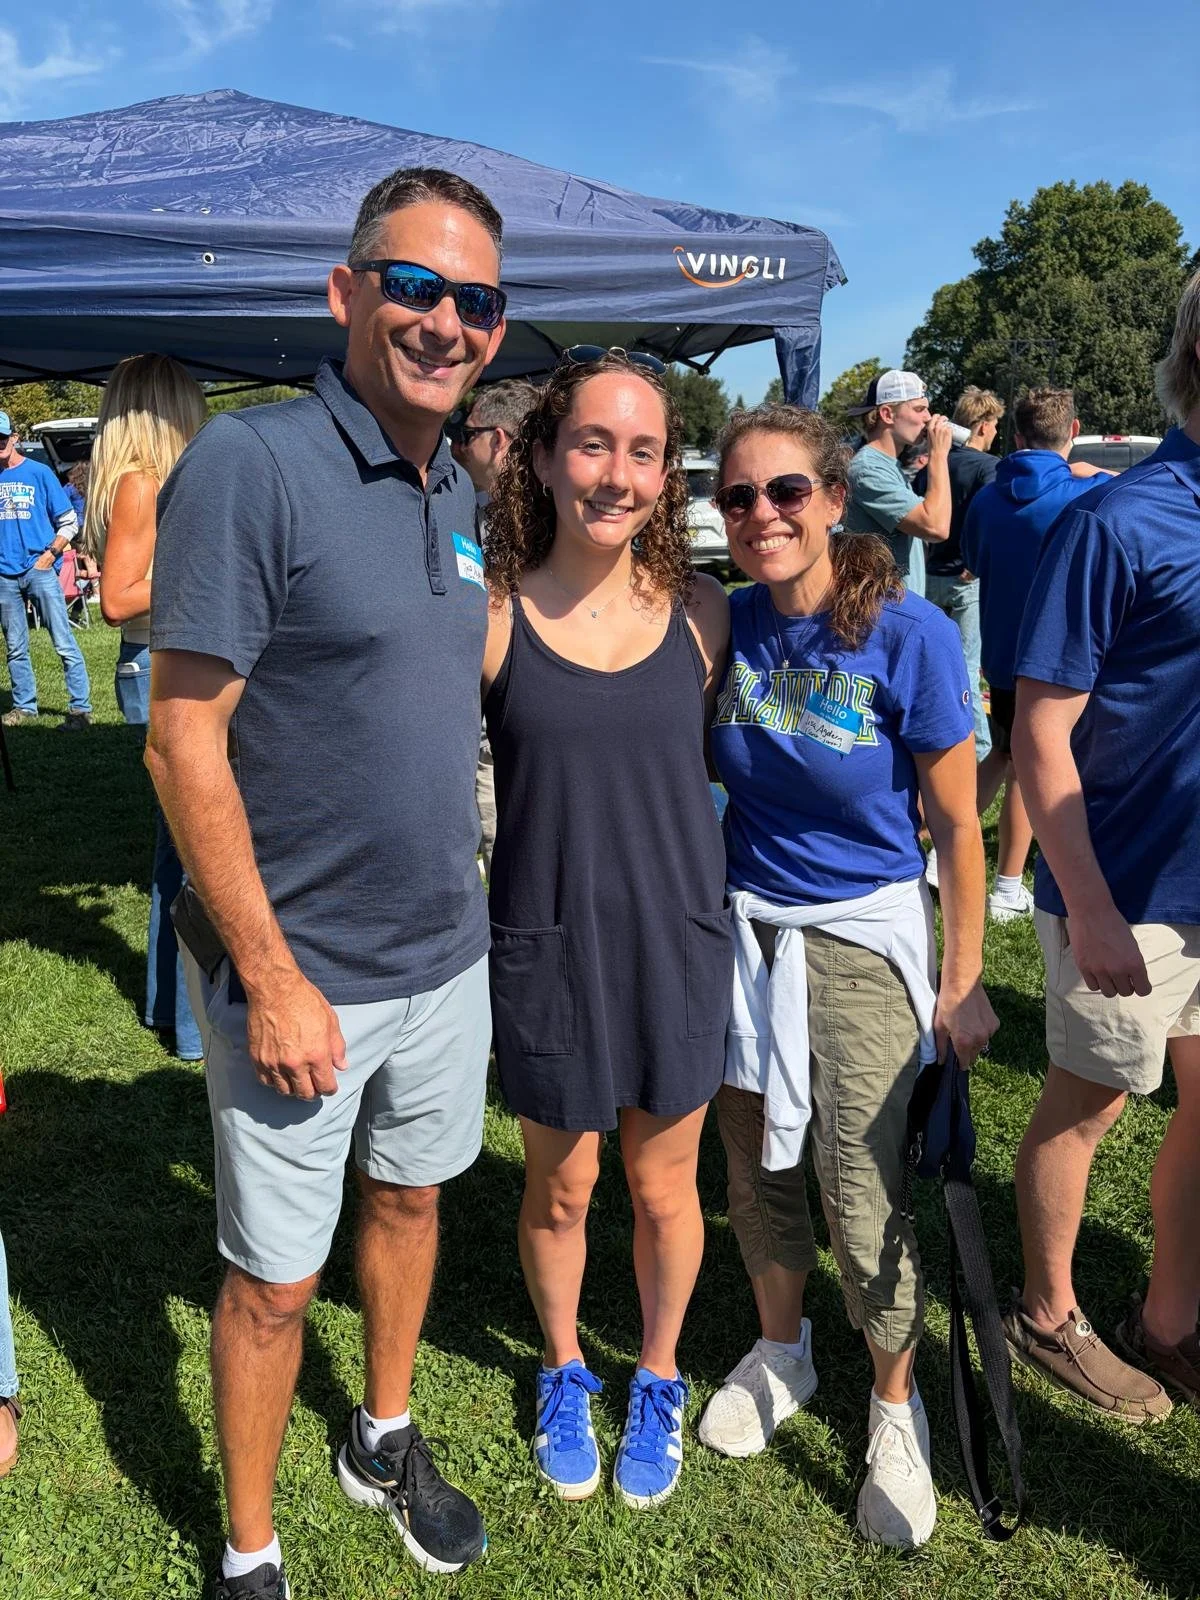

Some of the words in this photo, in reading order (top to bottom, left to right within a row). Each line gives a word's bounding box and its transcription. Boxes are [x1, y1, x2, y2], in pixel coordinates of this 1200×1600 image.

[686, 252, 786, 280] VINGLI
[711, 661, 881, 746] ELAWRE
[819, 698, 847, 720] Hello
